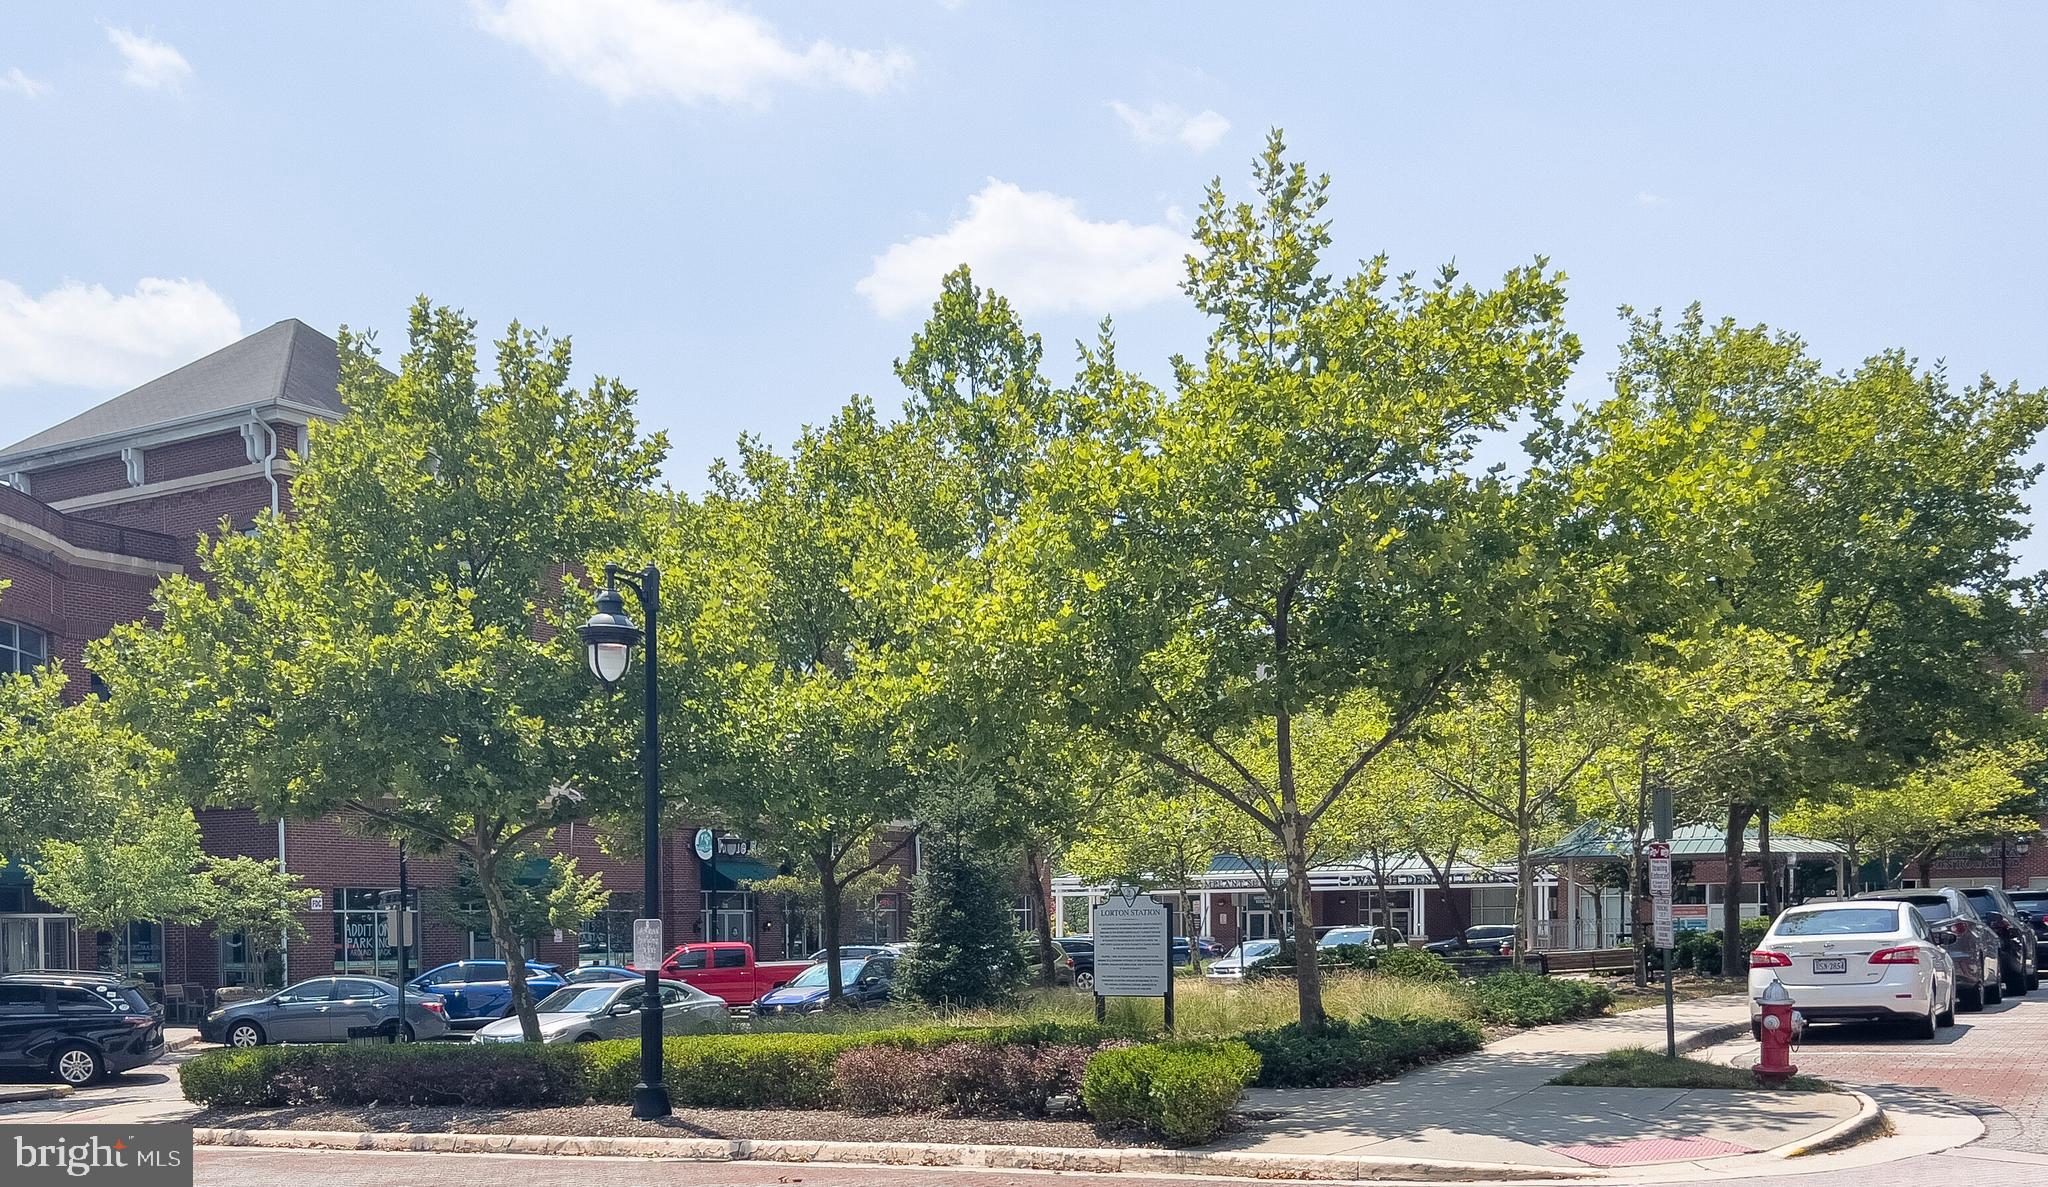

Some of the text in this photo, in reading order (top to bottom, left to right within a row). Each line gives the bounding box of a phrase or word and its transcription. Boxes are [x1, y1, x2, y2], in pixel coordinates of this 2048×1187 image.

[1355, 875, 1399, 885] WASH
[1406, 874, 1460, 885] DENL
[312, 899, 322, 908] FDC
[1101, 908, 1161, 917] LORTON STATION
[347, 937, 391, 949] PARKNG
